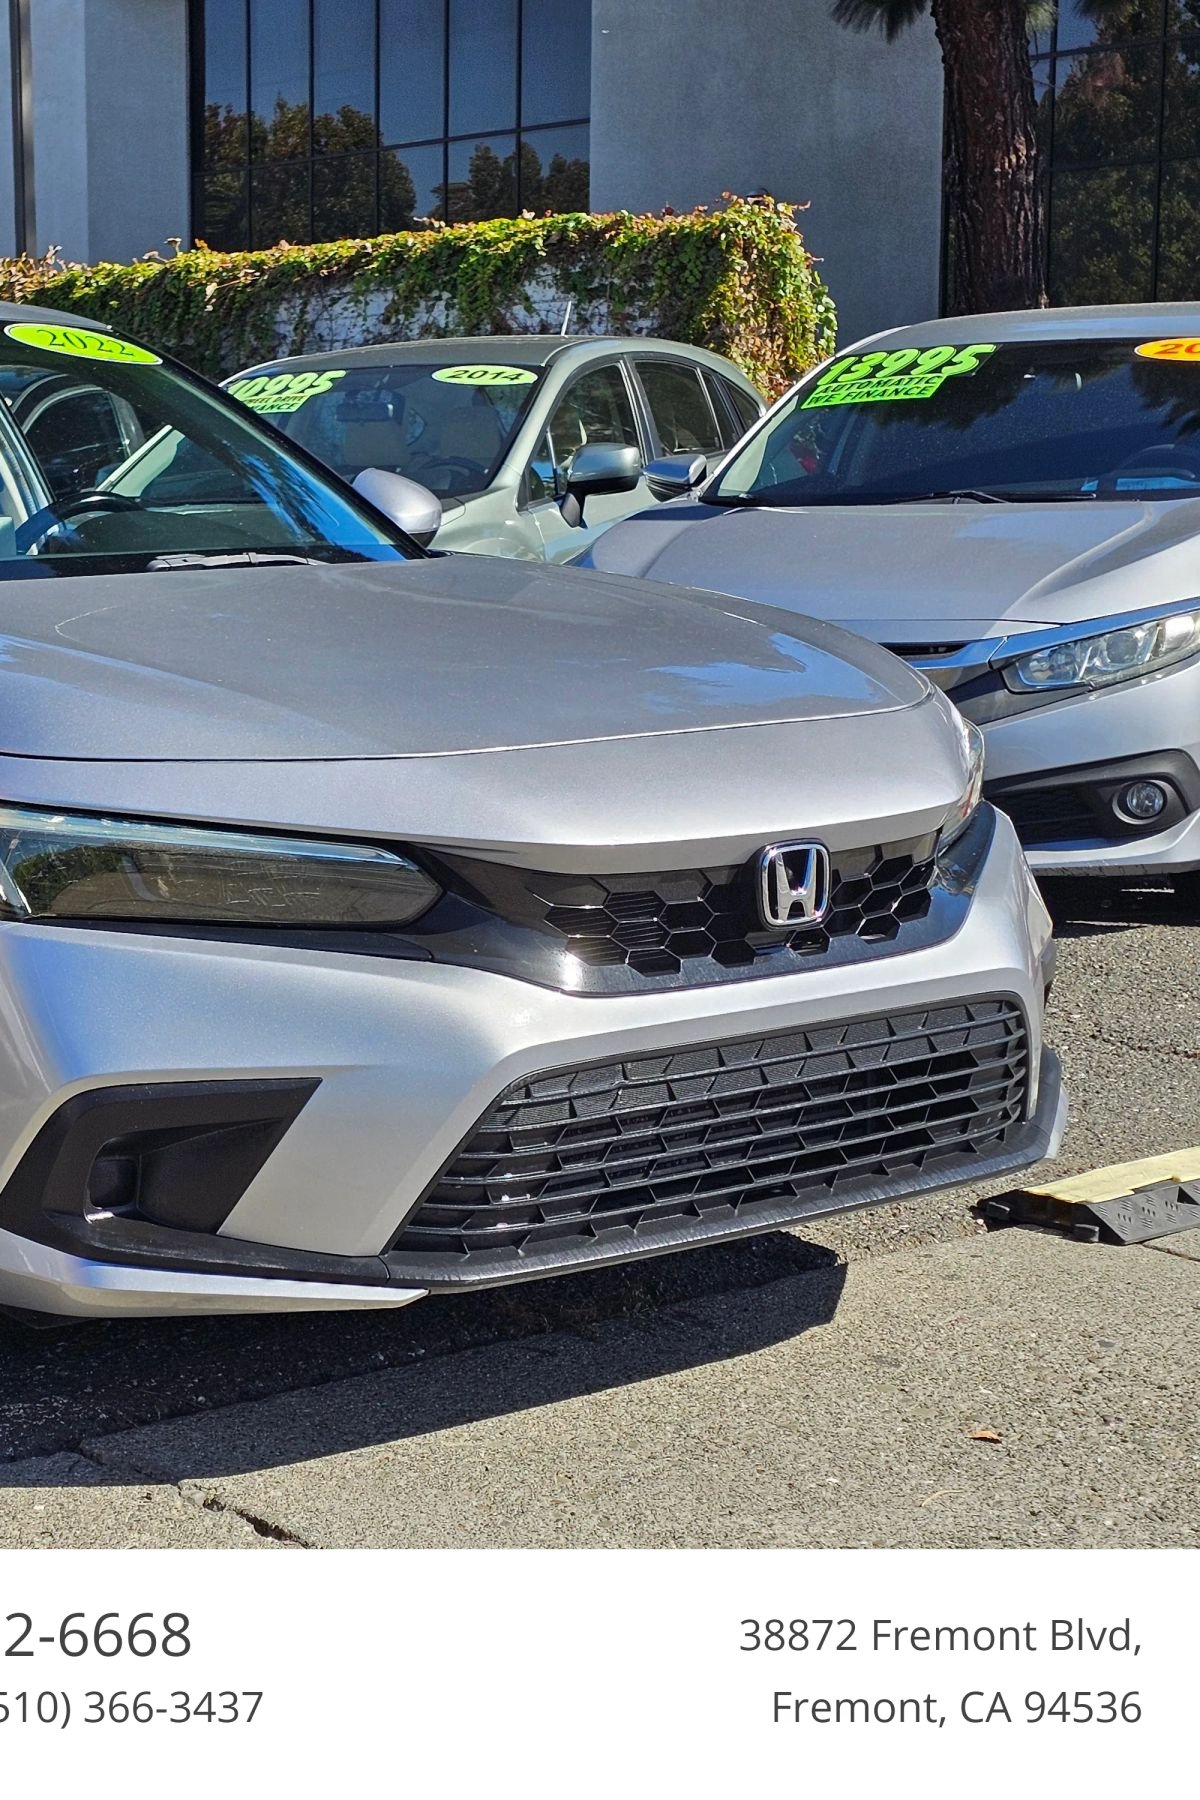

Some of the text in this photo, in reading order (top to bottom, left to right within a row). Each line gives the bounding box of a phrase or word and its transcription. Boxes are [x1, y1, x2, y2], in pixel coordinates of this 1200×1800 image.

[37, 329, 134, 356] 2022
[446, 369, 525, 381] 2014
[817, 344, 996, 385] 13995
[228, 370, 347, 400] 10995
[807, 386, 932, 406] WE FINANCE
[819, 375, 942, 395] AUTOMATIC
